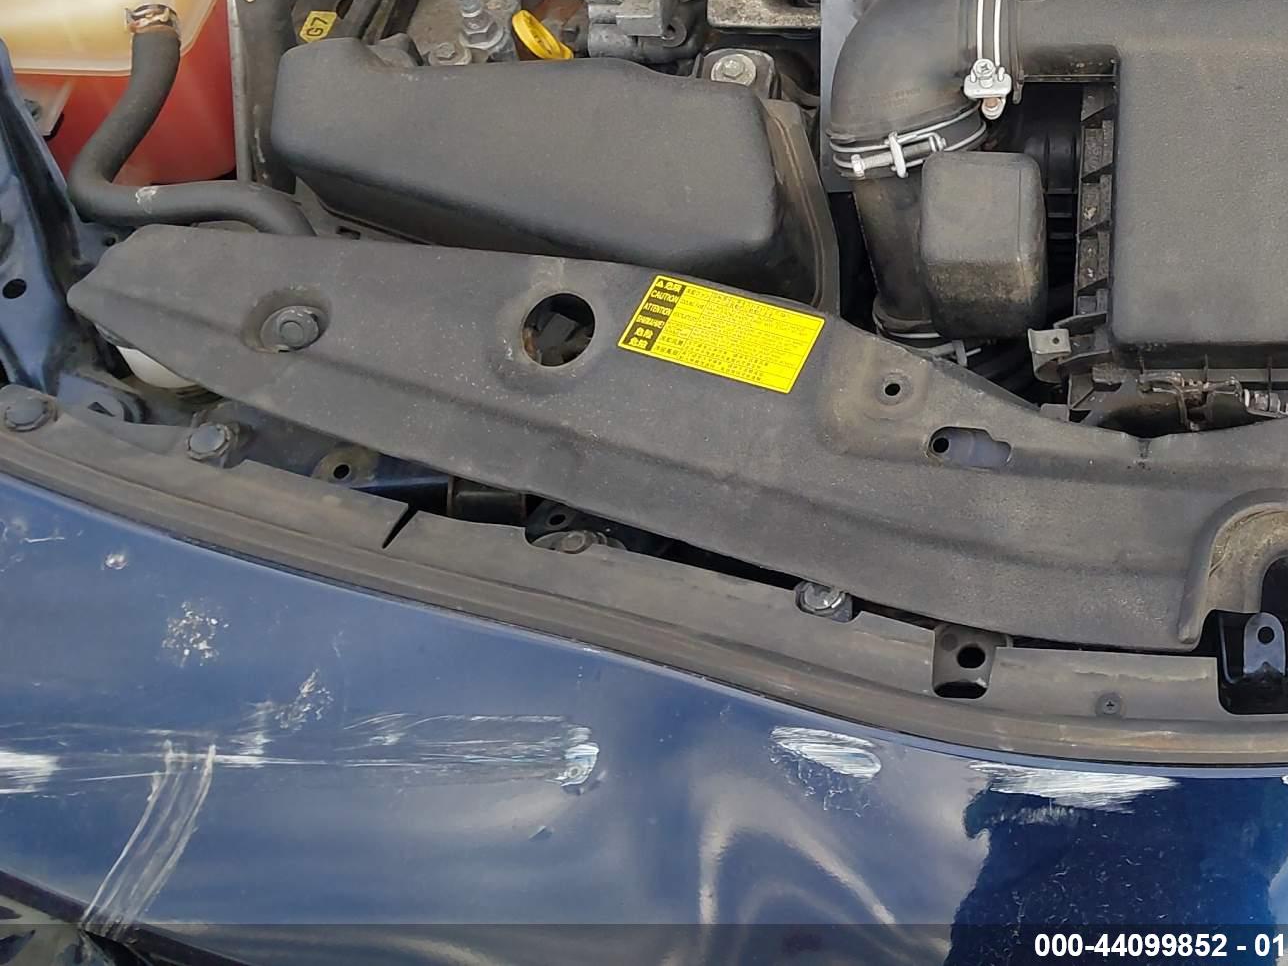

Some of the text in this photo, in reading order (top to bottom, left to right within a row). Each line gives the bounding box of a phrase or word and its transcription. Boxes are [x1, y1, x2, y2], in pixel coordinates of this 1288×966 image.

[306, 16, 329, 37] G7
[650, 289, 680, 304] CAUTION
[643, 302, 673, 316] ATTENTION
